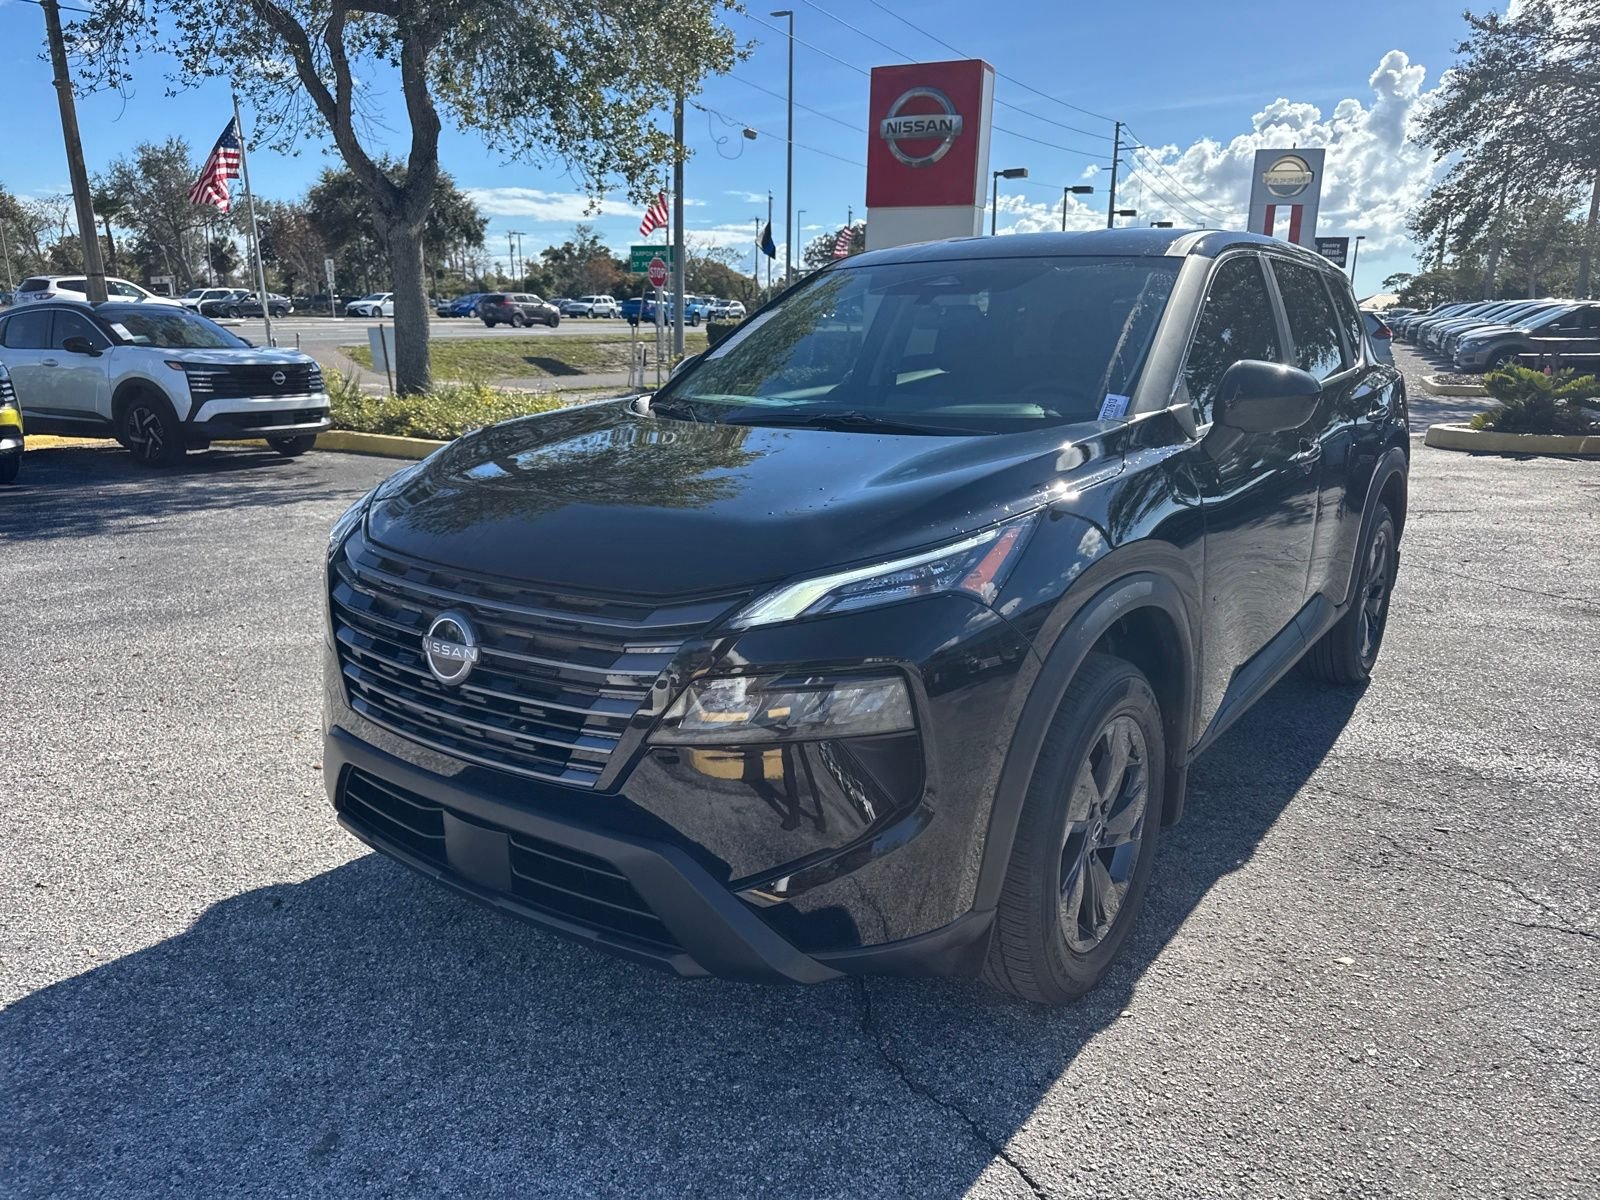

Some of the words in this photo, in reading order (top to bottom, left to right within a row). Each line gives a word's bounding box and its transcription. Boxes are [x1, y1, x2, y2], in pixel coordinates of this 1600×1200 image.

[886, 119, 953, 134] NISSAN
[649, 267, 665, 279] STOP
[423, 637, 476, 660] NISSAN
